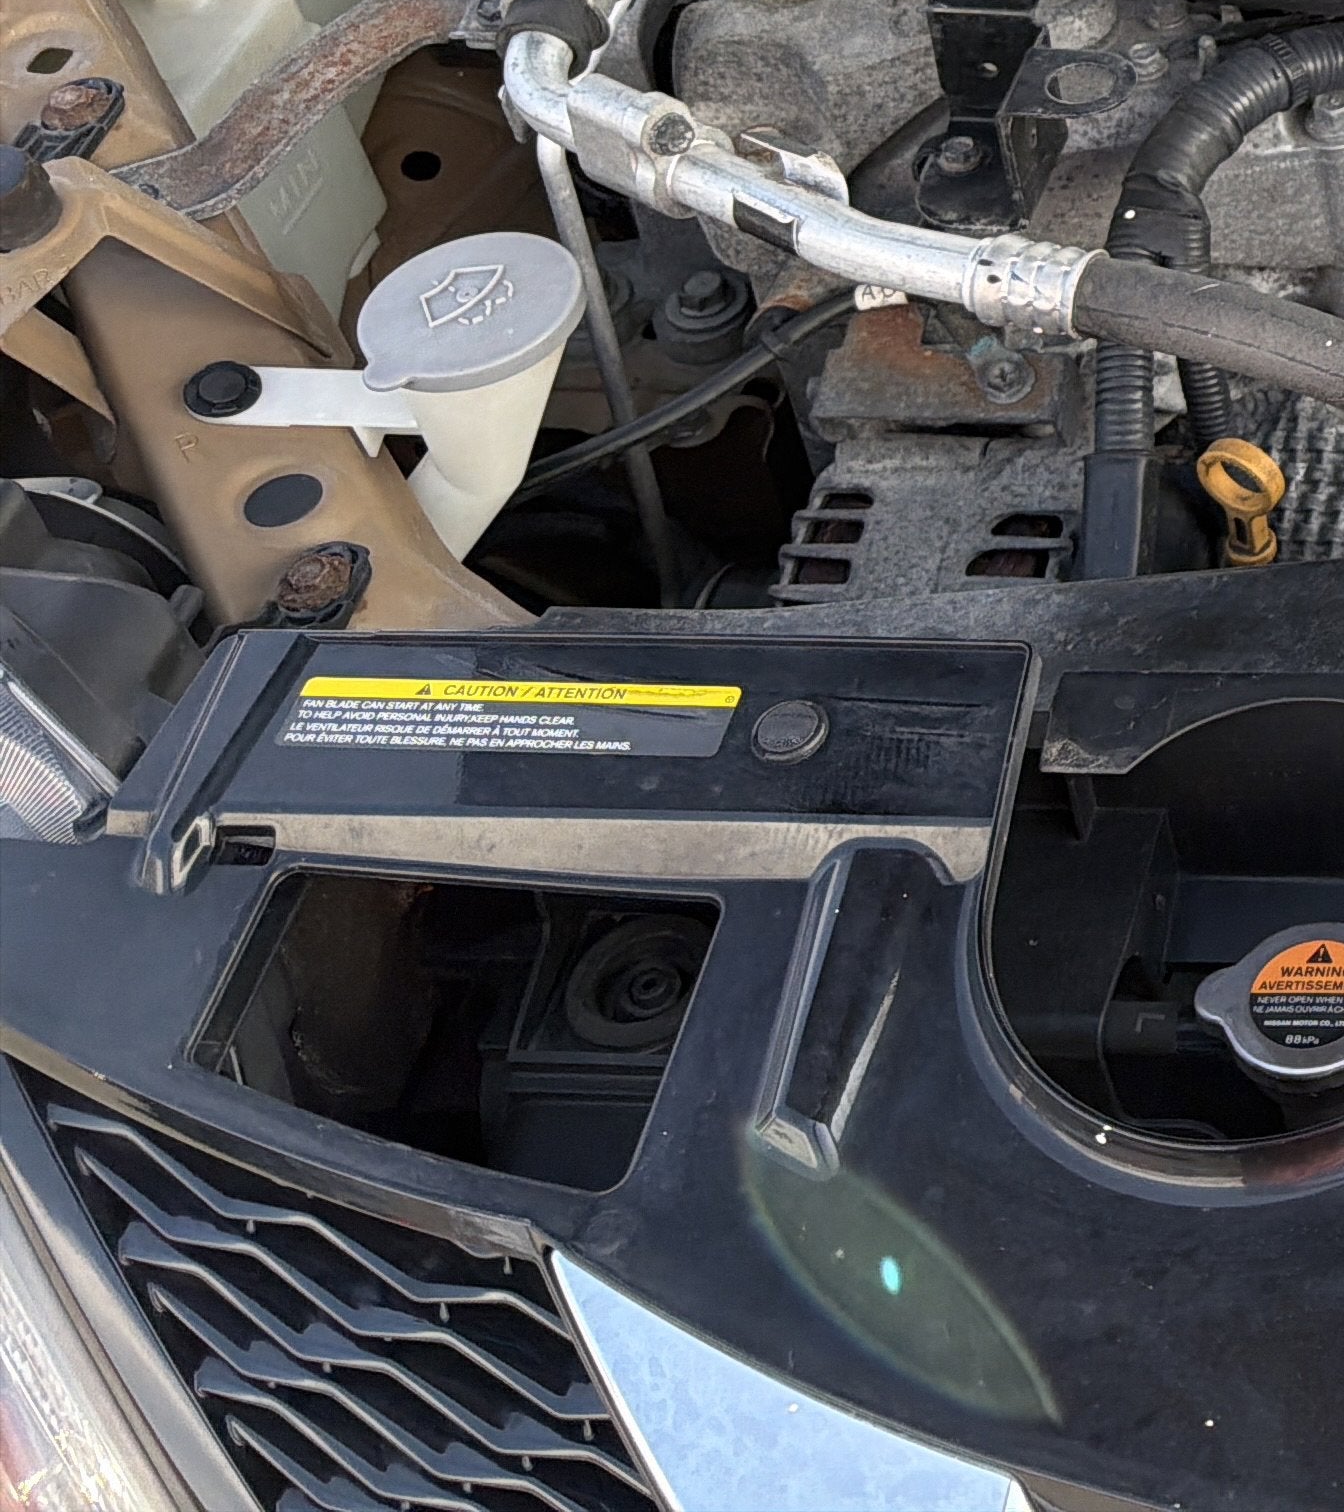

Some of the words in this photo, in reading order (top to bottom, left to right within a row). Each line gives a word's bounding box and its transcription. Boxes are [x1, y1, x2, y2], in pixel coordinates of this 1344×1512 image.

[443, 684, 519, 698] CAUTION
[536, 687, 628, 700] ATTENTION
[303, 699, 324, 709] FAN
[325, 700, 361, 709] BLADE
[361, 700, 385, 710] CAN
[385, 701, 419, 710] START
[420, 702, 434, 711] AT
[433, 702, 457, 711] ANY
[460, 703, 485, 712] TIME.
[298, 710, 313, 719] TO
[315, 711, 343, 719] HELP
[342, 711, 376, 721] AVOID
[377, 712, 433, 722] PERSONAL
[499, 715, 537, 724] HANDS
[538, 716, 575, 725] CLEAR.
[290, 722, 304, 731] LE
[306, 723, 374, 733] VENTILATEUR
[375, 724, 415, 734] RISQUE
[416, 725, 431, 734] DE
[432, 724, 492, 735] DÉMARRER
[492, 725, 501, 735] À
[503, 727, 531, 737] TOUT
[531, 728, 580, 738] MOMENT.
[284, 732, 317, 742] POUR
[318, 732, 354, 744] ÉVITER
[355, 734, 388, 744] TOUTE
[389, 735, 447, 747] BLESSURE,
[449, 737, 464, 746] NE
[466, 737, 489, 747] PAS
[489, 738, 505, 747] EN
[505, 739, 573, 749] APPROCHER
[574, 740, 595, 750] LES
[595, 741, 631, 750] MAINS.
[1257, 996, 1286, 1004] NEVER
[1288, 996, 1313, 1004] OPEN
[1315, 996, 1343, 1004] WHEN
